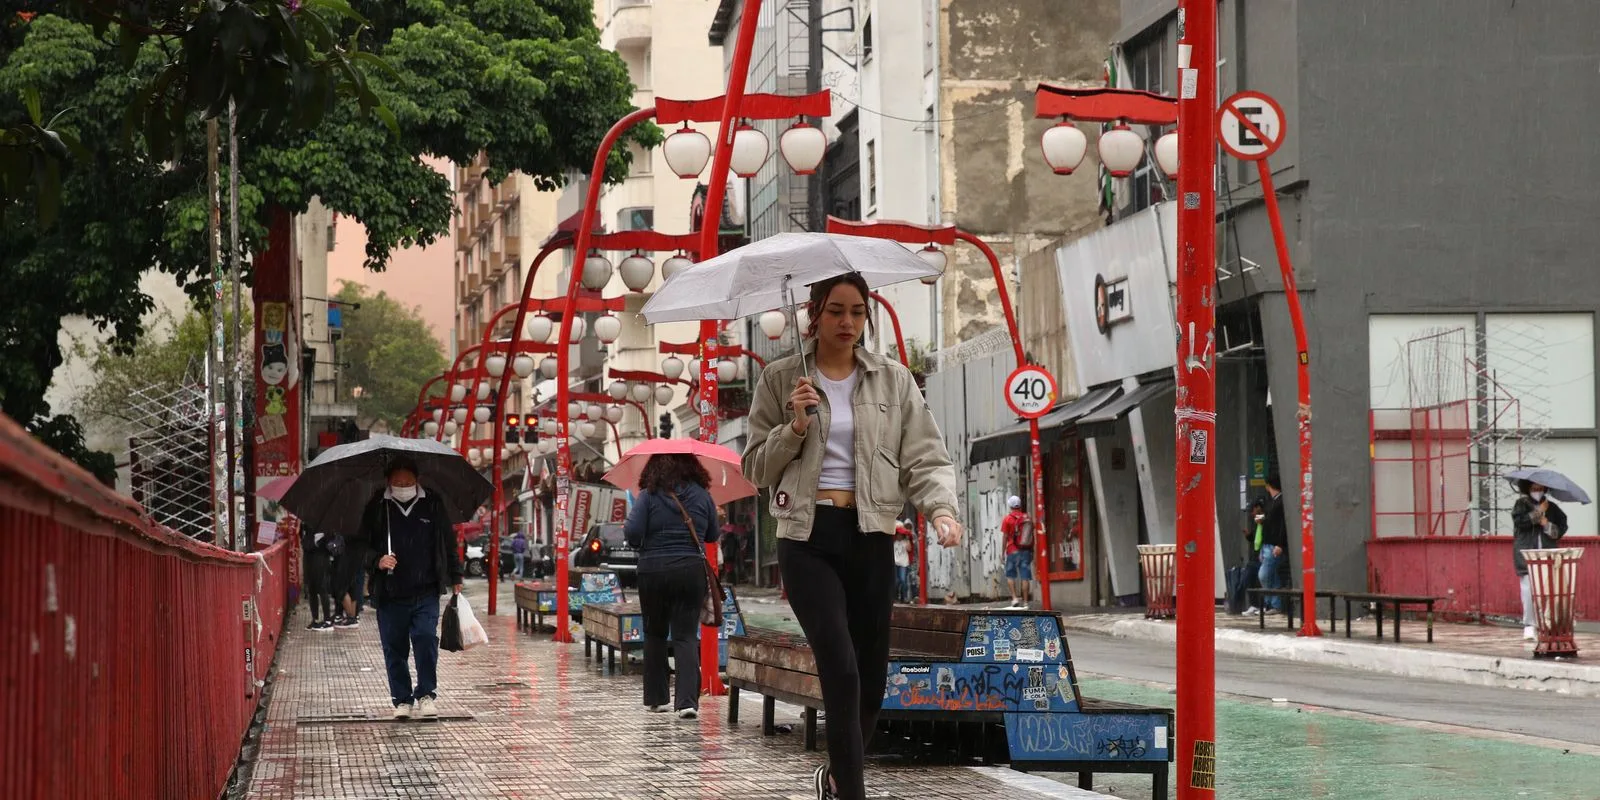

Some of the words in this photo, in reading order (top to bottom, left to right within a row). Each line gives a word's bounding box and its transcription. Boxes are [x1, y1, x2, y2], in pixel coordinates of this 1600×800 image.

[1238, 107, 1263, 145] E
[1014, 378, 1046, 400] 40
[967, 647, 984, 656] POISE
